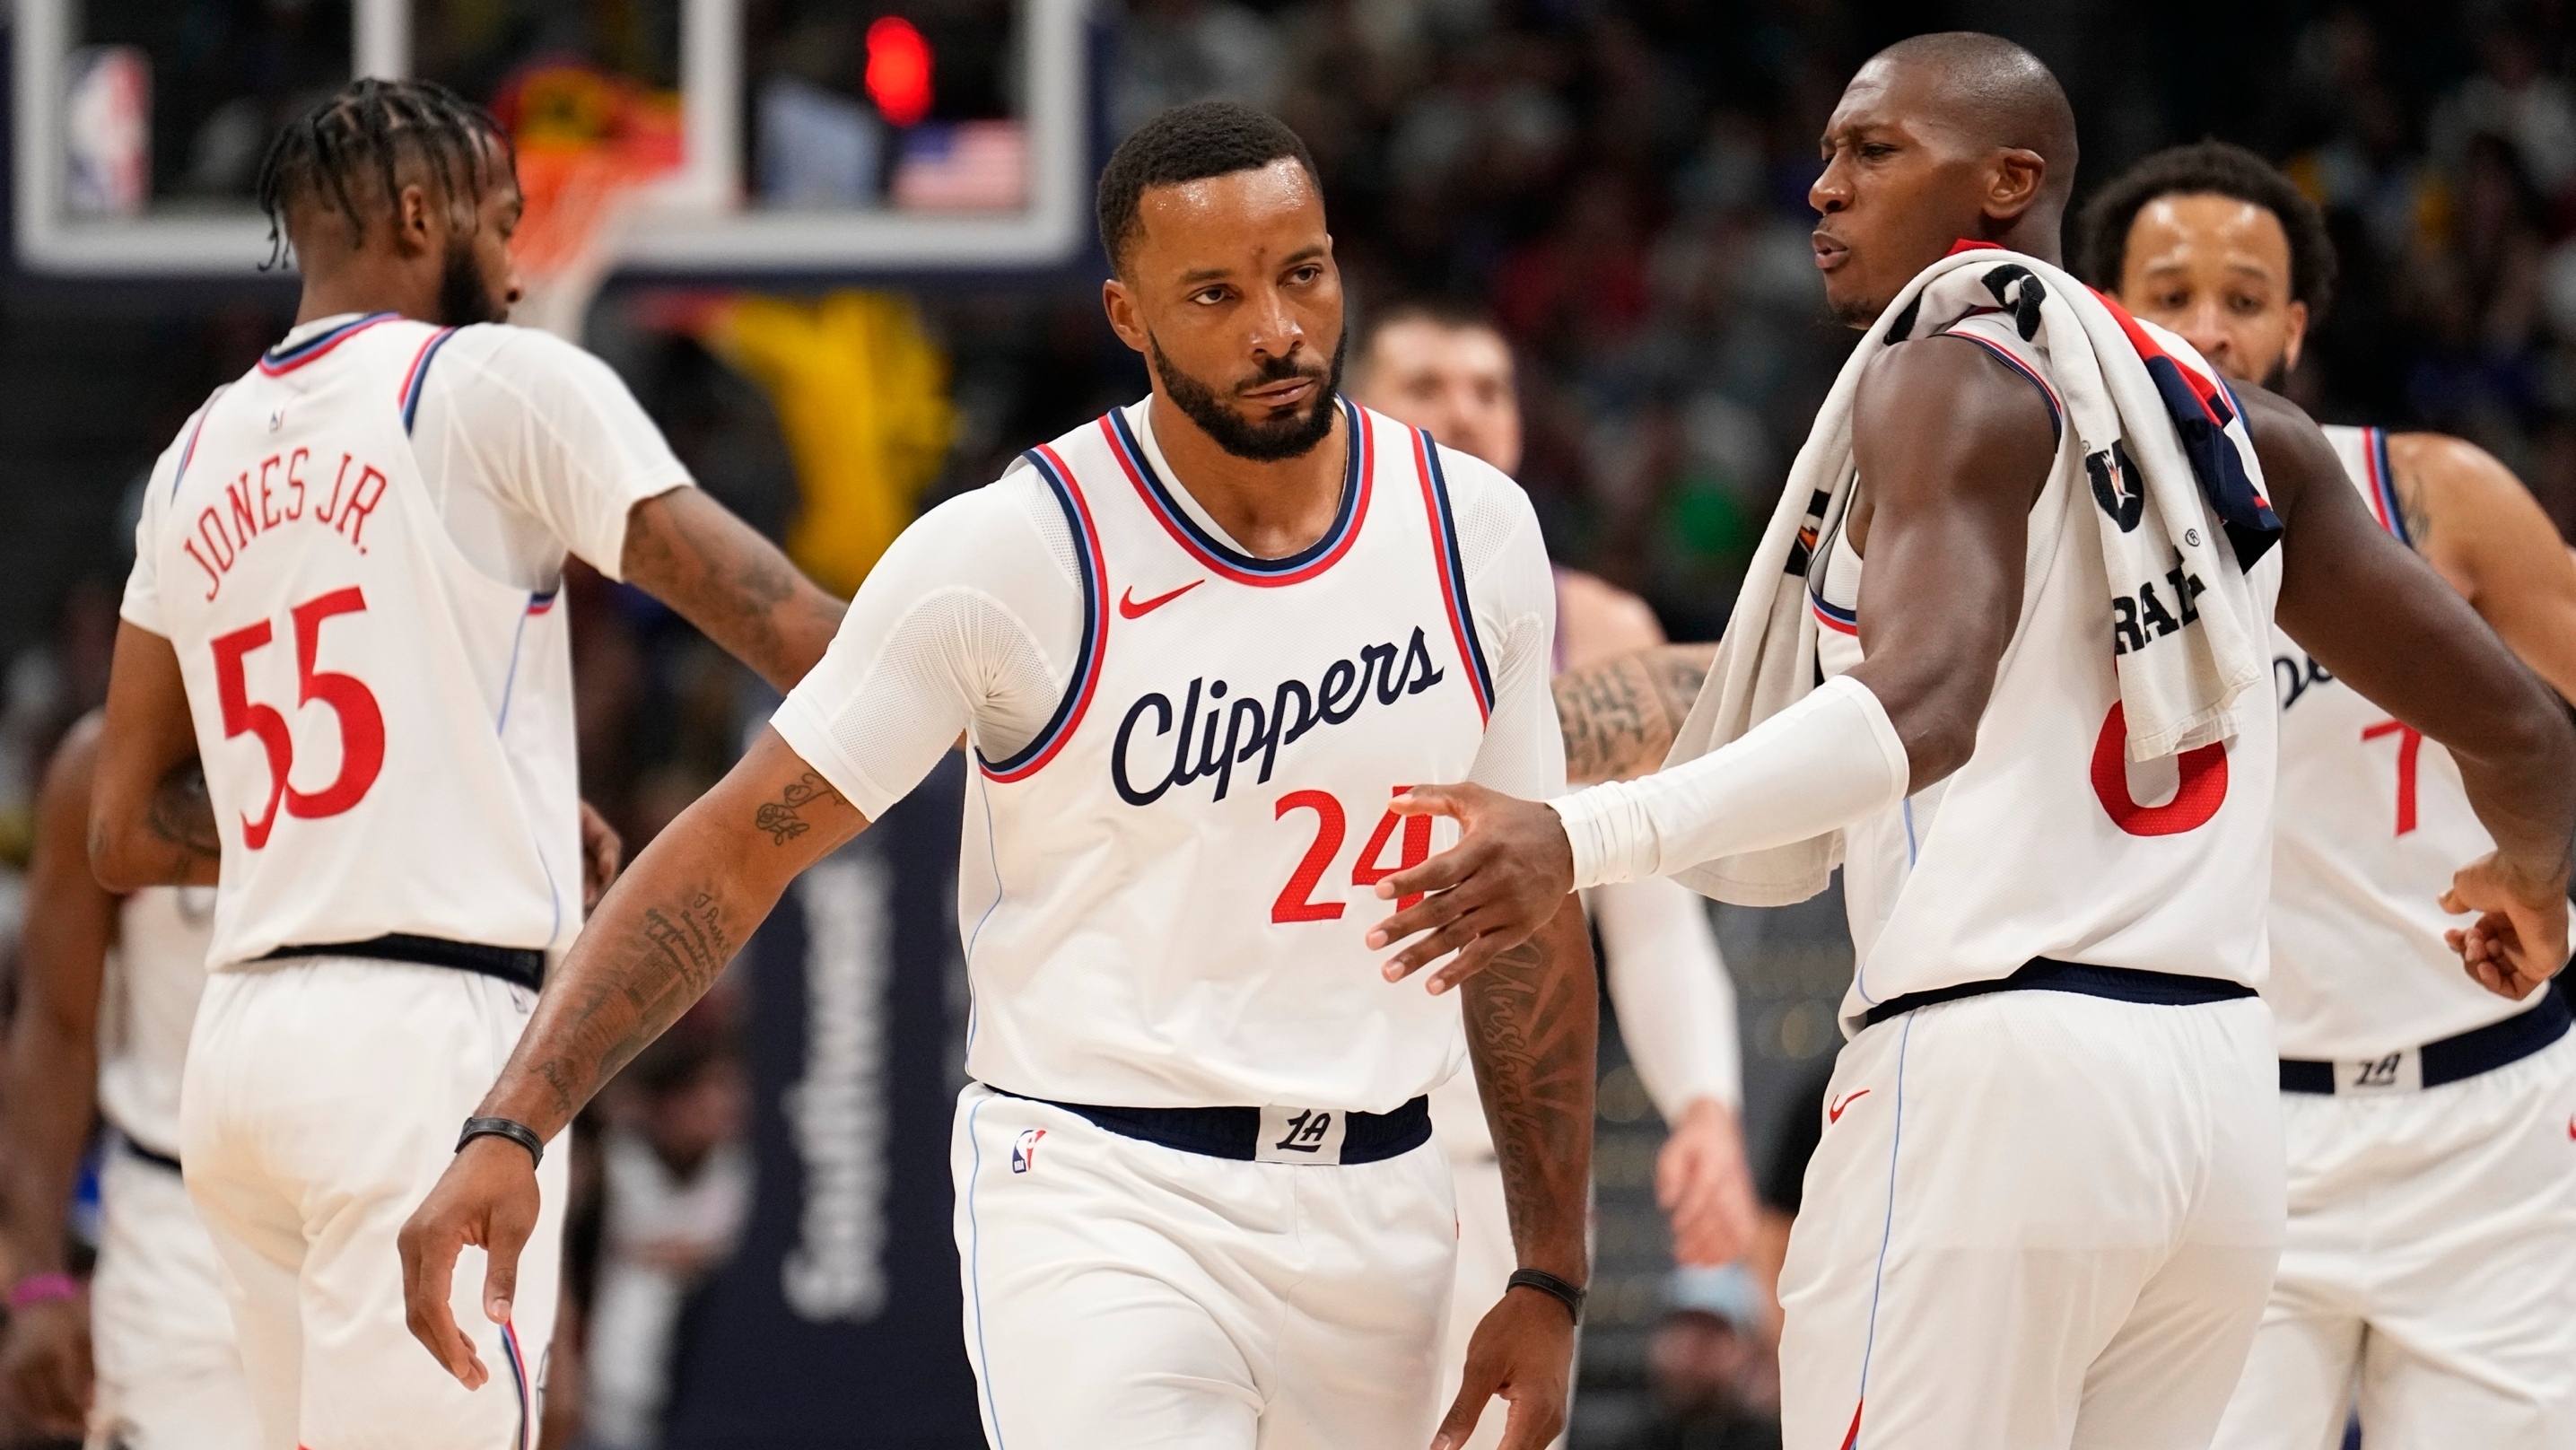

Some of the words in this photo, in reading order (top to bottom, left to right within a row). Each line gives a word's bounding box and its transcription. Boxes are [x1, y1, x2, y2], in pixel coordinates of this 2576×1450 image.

[184, 447, 309, 603] JONES
[315, 451, 387, 556] JR.
[210, 584, 386, 851] 55
[1111, 625, 1445, 806] Clippers
[2361, 719, 2423, 838] 7
[1271, 786, 1434, 924] 24
[1275, 1108, 1332, 1154] LA
